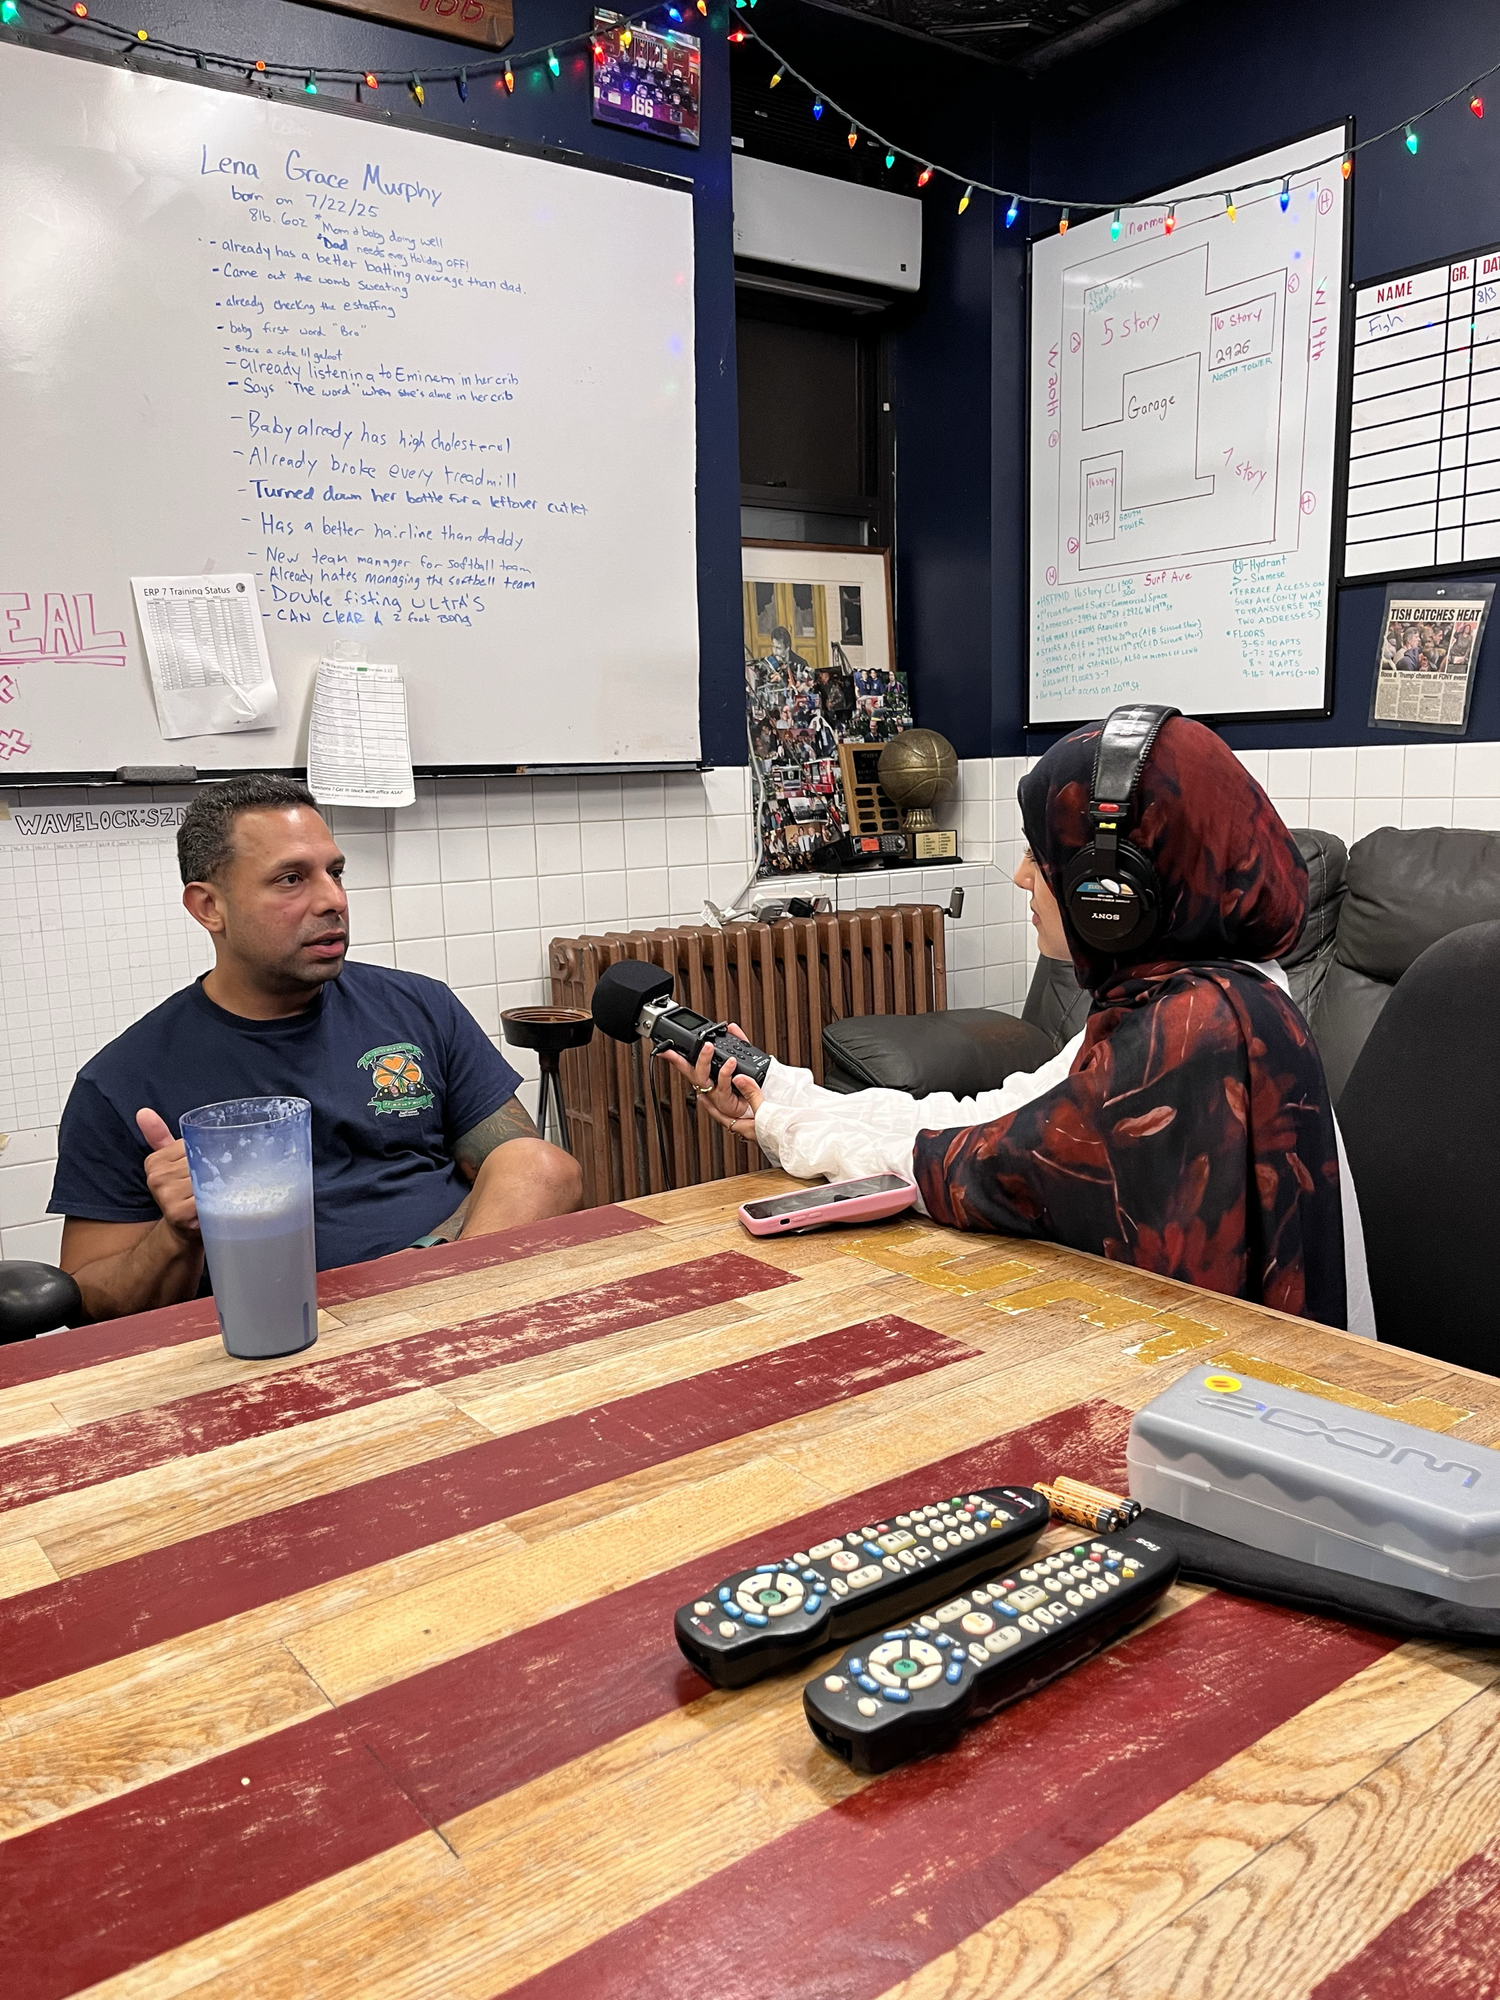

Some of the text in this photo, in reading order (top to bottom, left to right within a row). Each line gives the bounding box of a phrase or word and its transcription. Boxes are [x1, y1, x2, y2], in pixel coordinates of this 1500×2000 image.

[631, 94, 654, 118] 166
[201, 144, 442, 207] Lena Grace Murphy
[231, 185, 379, 218] born on 7/22/25
[322, 221, 443, 250] Mom baby doing well
[323, 236, 349, 250] Dad
[221, 239, 527, 295] already has a better batting average than dad.
[223, 262, 350, 287] Came out the womb
[1377, 266, 1469, 303] NAME GR.
[225, 294, 337, 314] already the
[229, 320, 326, 340] baby first word
[1101, 317, 1114, 346] 5
[1213, 315, 1225, 331] 16
[276, 346, 298, 358] cute
[1215, 340, 1251, 364] 2926
[308, 361, 519, 386] listening to Eminem in her crib
[1212, 356, 1273, 383] NORTH TOWER
[243, 378, 514, 402] Says when crib
[1127, 395, 1176, 422] Garage
[249, 410, 511, 453] Baby already has high cholesterol
[249, 448, 517, 489] Already broke every treadmill
[249, 479, 588, 516] Turned down her bottle a leftover cutlet
[1087, 512, 1111, 528] 2943
[1118, 509, 1142, 522] SOUTH
[1118, 518, 1146, 533] TOWER
[261, 511, 524, 550] Has a better hairline than daddy
[266, 546, 532, 574] New team manager for softball team
[269, 568, 536, 591] Already hates managing the softball team
[1171, 571, 1192, 584] Ave
[1250, 571, 1286, 583] Siamese
[143, 586, 231, 597] ERP 7 Training Status
[272, 584, 402, 613] Double fisting
[1300, 589, 1322, 600] WAY
[1247, 601, 1304, 614] TRANSVERSE
[1308, 599, 1323, 609] THE
[1391, 608, 1482, 622] TISH CATCHES HEAT
[277, 609, 431, 626] CAN A 2 foot
[1238, 616, 1255, 625] TWO
[1233, 628, 1265, 638] FLOORS
[1266, 638, 1301, 647] 40 APTS
[1268, 649, 1303, 658] 25 APTS
[1277, 659, 1300, 668] APTS
[1091, 912, 1120, 921] SONY
